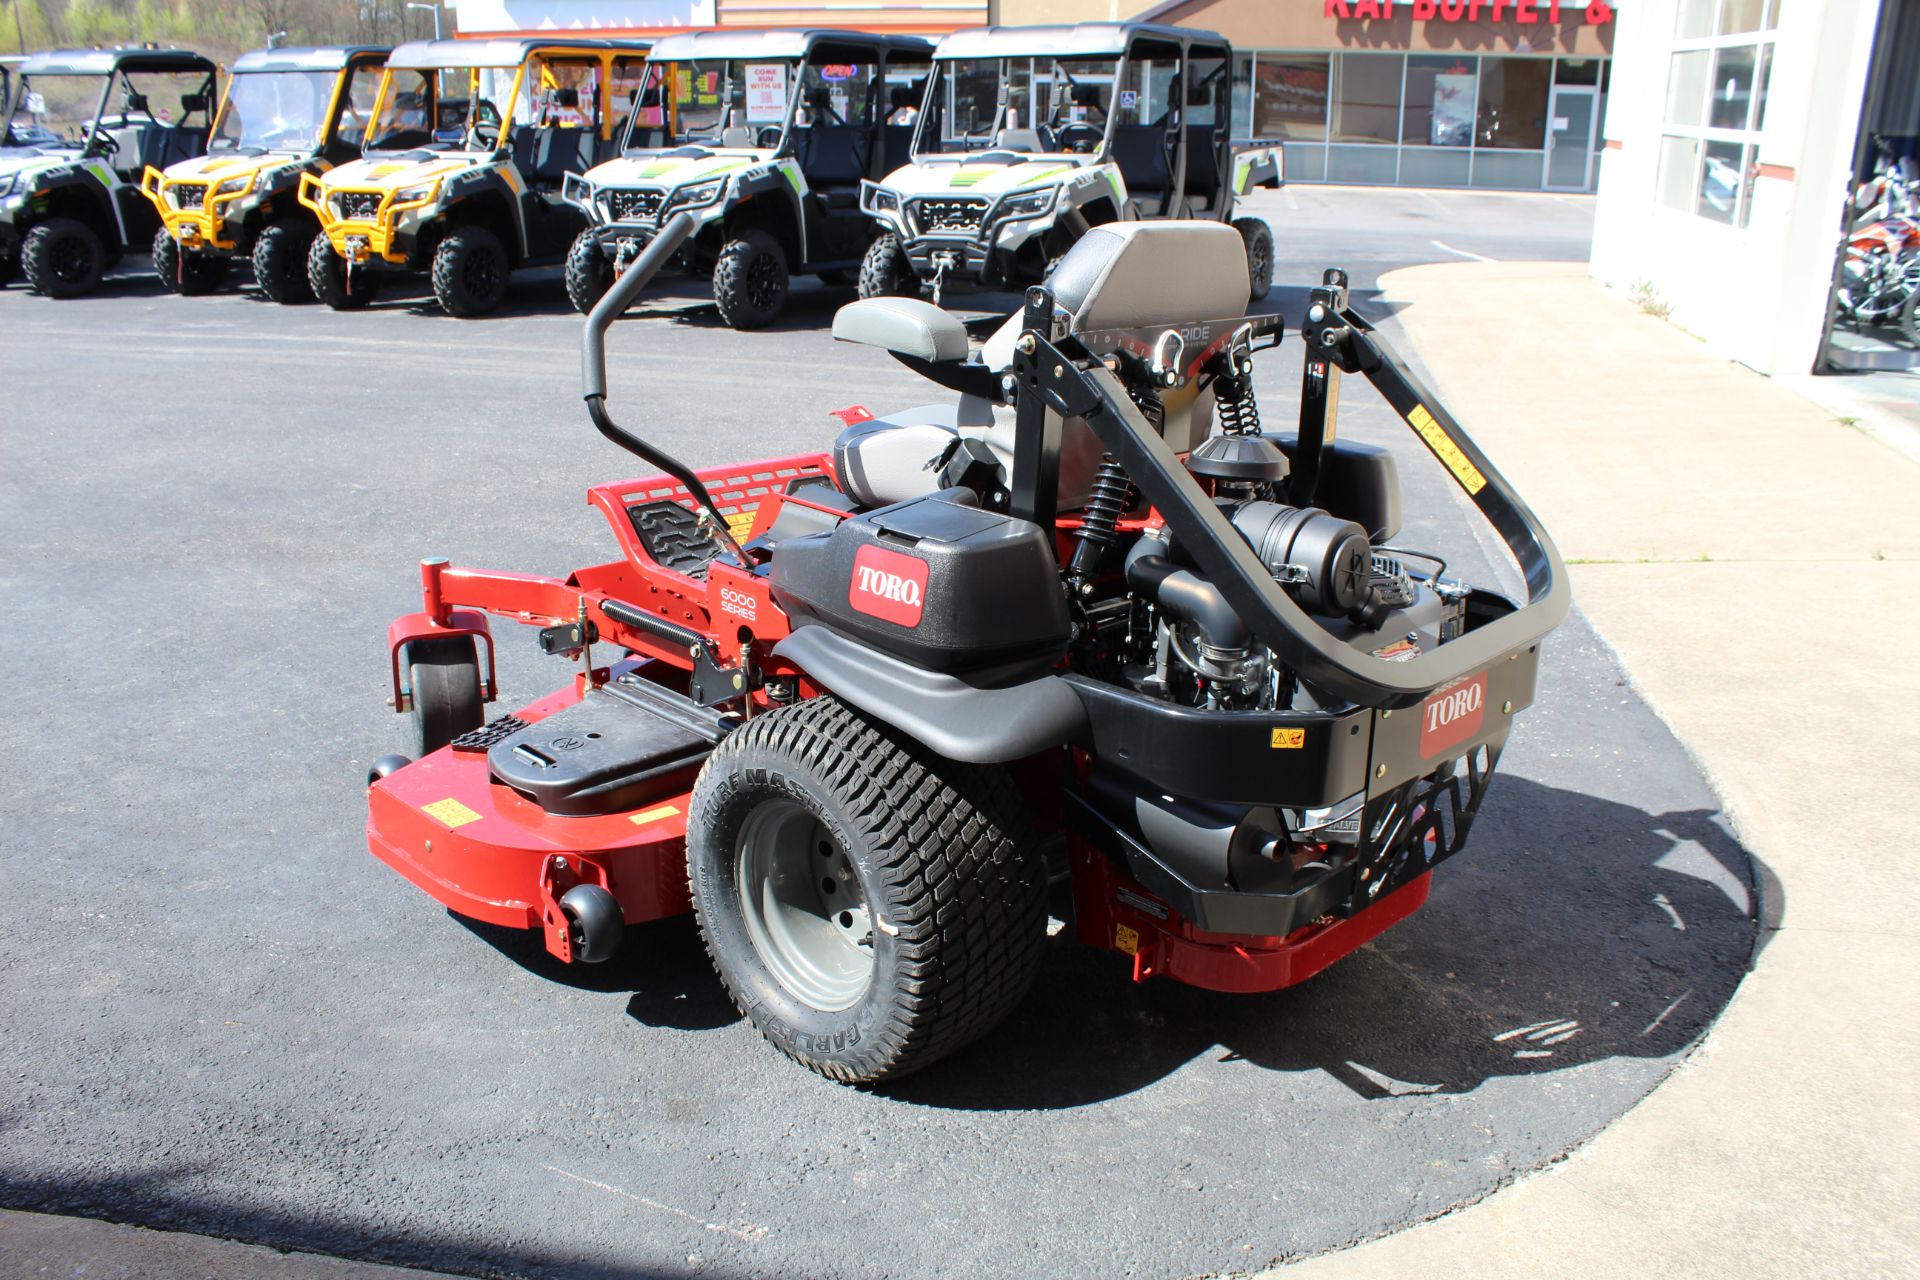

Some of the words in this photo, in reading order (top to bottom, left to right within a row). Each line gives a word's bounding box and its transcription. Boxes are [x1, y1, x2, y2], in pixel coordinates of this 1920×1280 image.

[1412, 0, 1560, 25] BUFFET
[1585, 0, 1613, 25] &
[825, 65, 852, 77] OPEN
[720, 587, 756, 609] 6000
[720, 600, 756, 621] SERIES
[701, 772, 740, 831] TURF
[745, 768, 852, 852] MASTER
[738, 987, 862, 1054] CARLISLE
